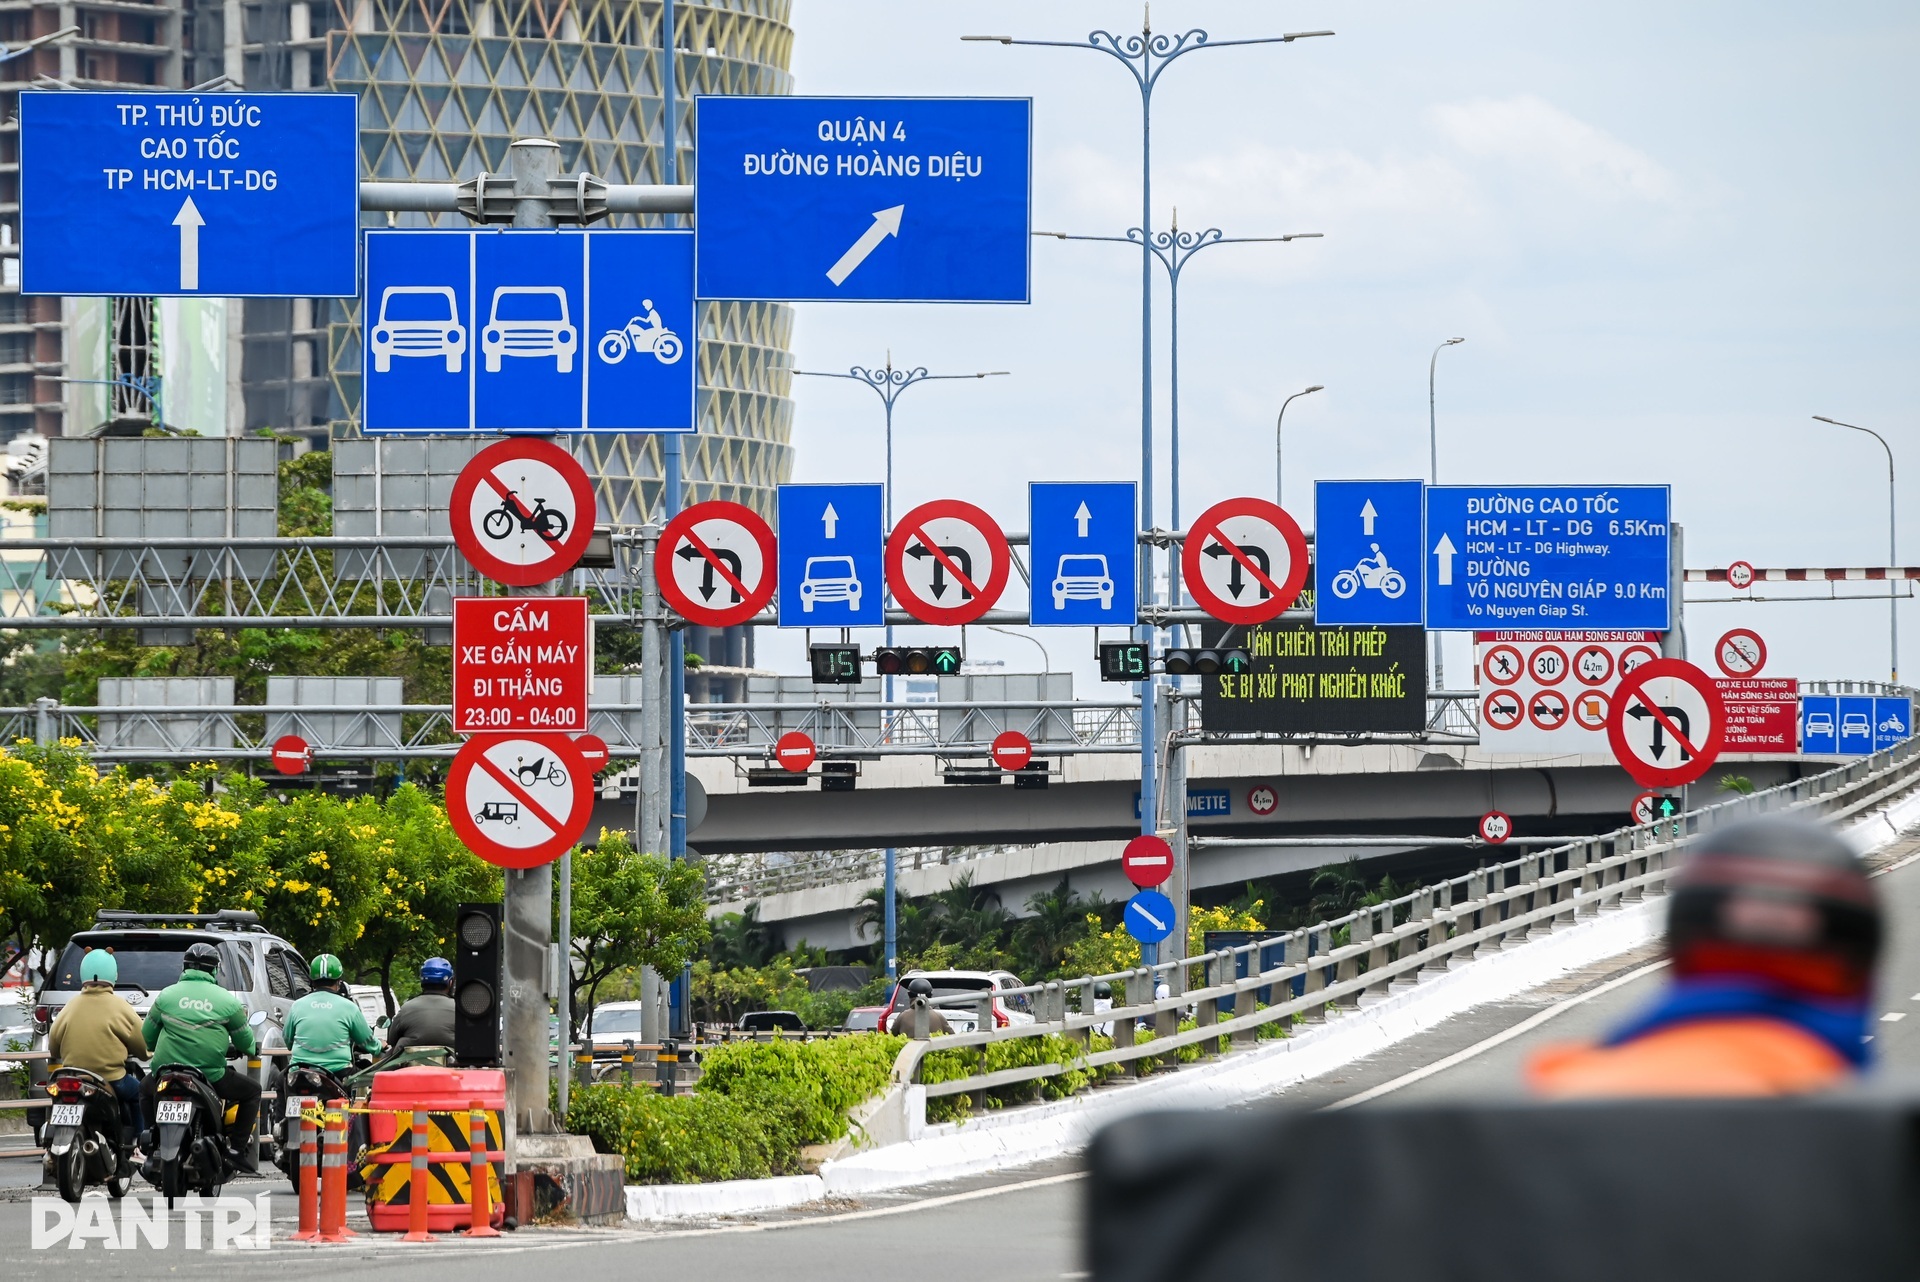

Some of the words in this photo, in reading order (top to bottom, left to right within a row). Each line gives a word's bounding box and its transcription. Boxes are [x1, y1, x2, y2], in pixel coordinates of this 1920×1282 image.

[117, 104, 149, 126] TP.
[155, 97, 203, 127] THỦ
[211, 99, 261, 127] ĐỨC
[817, 115, 886, 147] QUẬN
[892, 120, 906, 142] 4
[140, 137, 187, 159] CAO
[193, 130, 240, 159] TỐC
[743, 148, 829, 176] ĐƯỜNG
[836, 149, 920, 177] HOÀNG
[927, 150, 982, 182] DIỆU
[103, 168, 133, 190] TP
[143, 169, 277, 191] HCM-LT-DG
[1466, 493, 1534, 514] ĐƯỜNG
[1539, 497, 1578, 514] CAO
[1583, 491, 1620, 514] TỐC
[1466, 519, 1507, 536] HCM
[1526, 519, 1548, 536] LT
[1567, 519, 1593, 536] DG
[1608, 519, 1666, 537] 6.5Km
[1466, 542, 1495, 554] HCM
[1507, 542, 1522, 554] LT
[1534, 542, 1552, 554] DG
[1556, 542, 1611, 557] Highway.
[1466, 556, 1531, 577] ĐƯỜNG
[1467, 579, 1489, 599] VÕ
[1494, 579, 1563, 599] NGUYÊN
[1567, 578, 1607, 599] GIÁP
[1614, 583, 1636, 599] 9.0
[1640, 583, 1665, 599] Km
[493, 602, 549, 632] CẤM
[1467, 604, 1483, 616] Vo
[1486, 604, 1535, 618] Nguyen
[1538, 604, 1567, 618] Giap
[1571, 604, 1589, 616] St.
[461, 645, 486, 664] XE
[490, 636, 531, 664] GẮN
[537, 640, 578, 664] MÁY
[1320, 625, 1349, 657] TRÁI
[1353, 625, 1387, 657] PHÉP
[829, 650, 854, 677] 15
[1118, 647, 1143, 674] 15
[473, 678, 492, 697] ĐI
[496, 667, 563, 697] THẲNG
[1240, 673, 1254, 702] BỊ
[1281, 673, 1315, 702] PHẠT
[1319, 666, 1367, 698] NGHIÊM
[1370, 661, 1406, 698] KHẮC
[1715, 681, 1729, 690] OẠI
[1731, 681, 1741, 689] XE
[464, 707, 511, 726] 23:00
[529, 706, 576, 726] 04:00
[179, 997, 213, 1012] Grab
[310, 1001, 333, 1009] Grab
